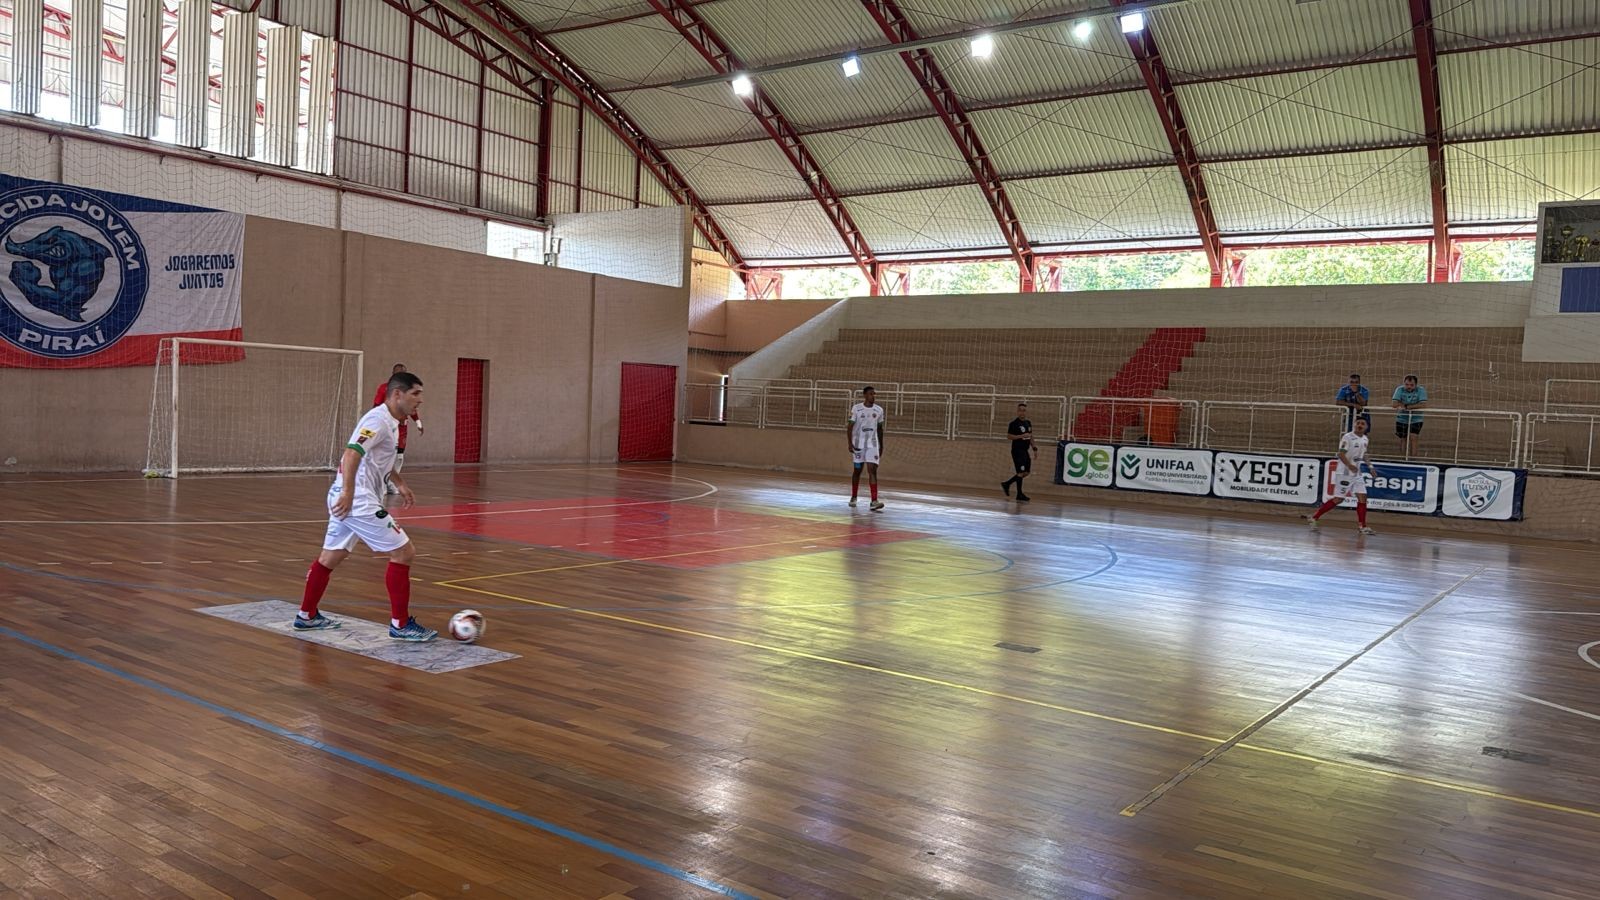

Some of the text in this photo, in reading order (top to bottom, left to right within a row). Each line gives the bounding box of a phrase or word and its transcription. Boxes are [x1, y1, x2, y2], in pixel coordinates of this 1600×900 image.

[0, 194, 141, 271] CIDA JOVEM
[165, 254, 235, 272] JOGAREMOS
[179, 273, 224, 290] JUNTOS
[18, 326, 106, 351] PIRAÍ
[1067, 447, 1110, 478] ge
[1146, 458, 1195, 472] UNIFAA
[1229, 459, 1304, 487] YESU
[1230, 485, 1299, 496] MOBILIDADE ELÉTRICA
[1363, 472, 1423, 494] Gaspi
